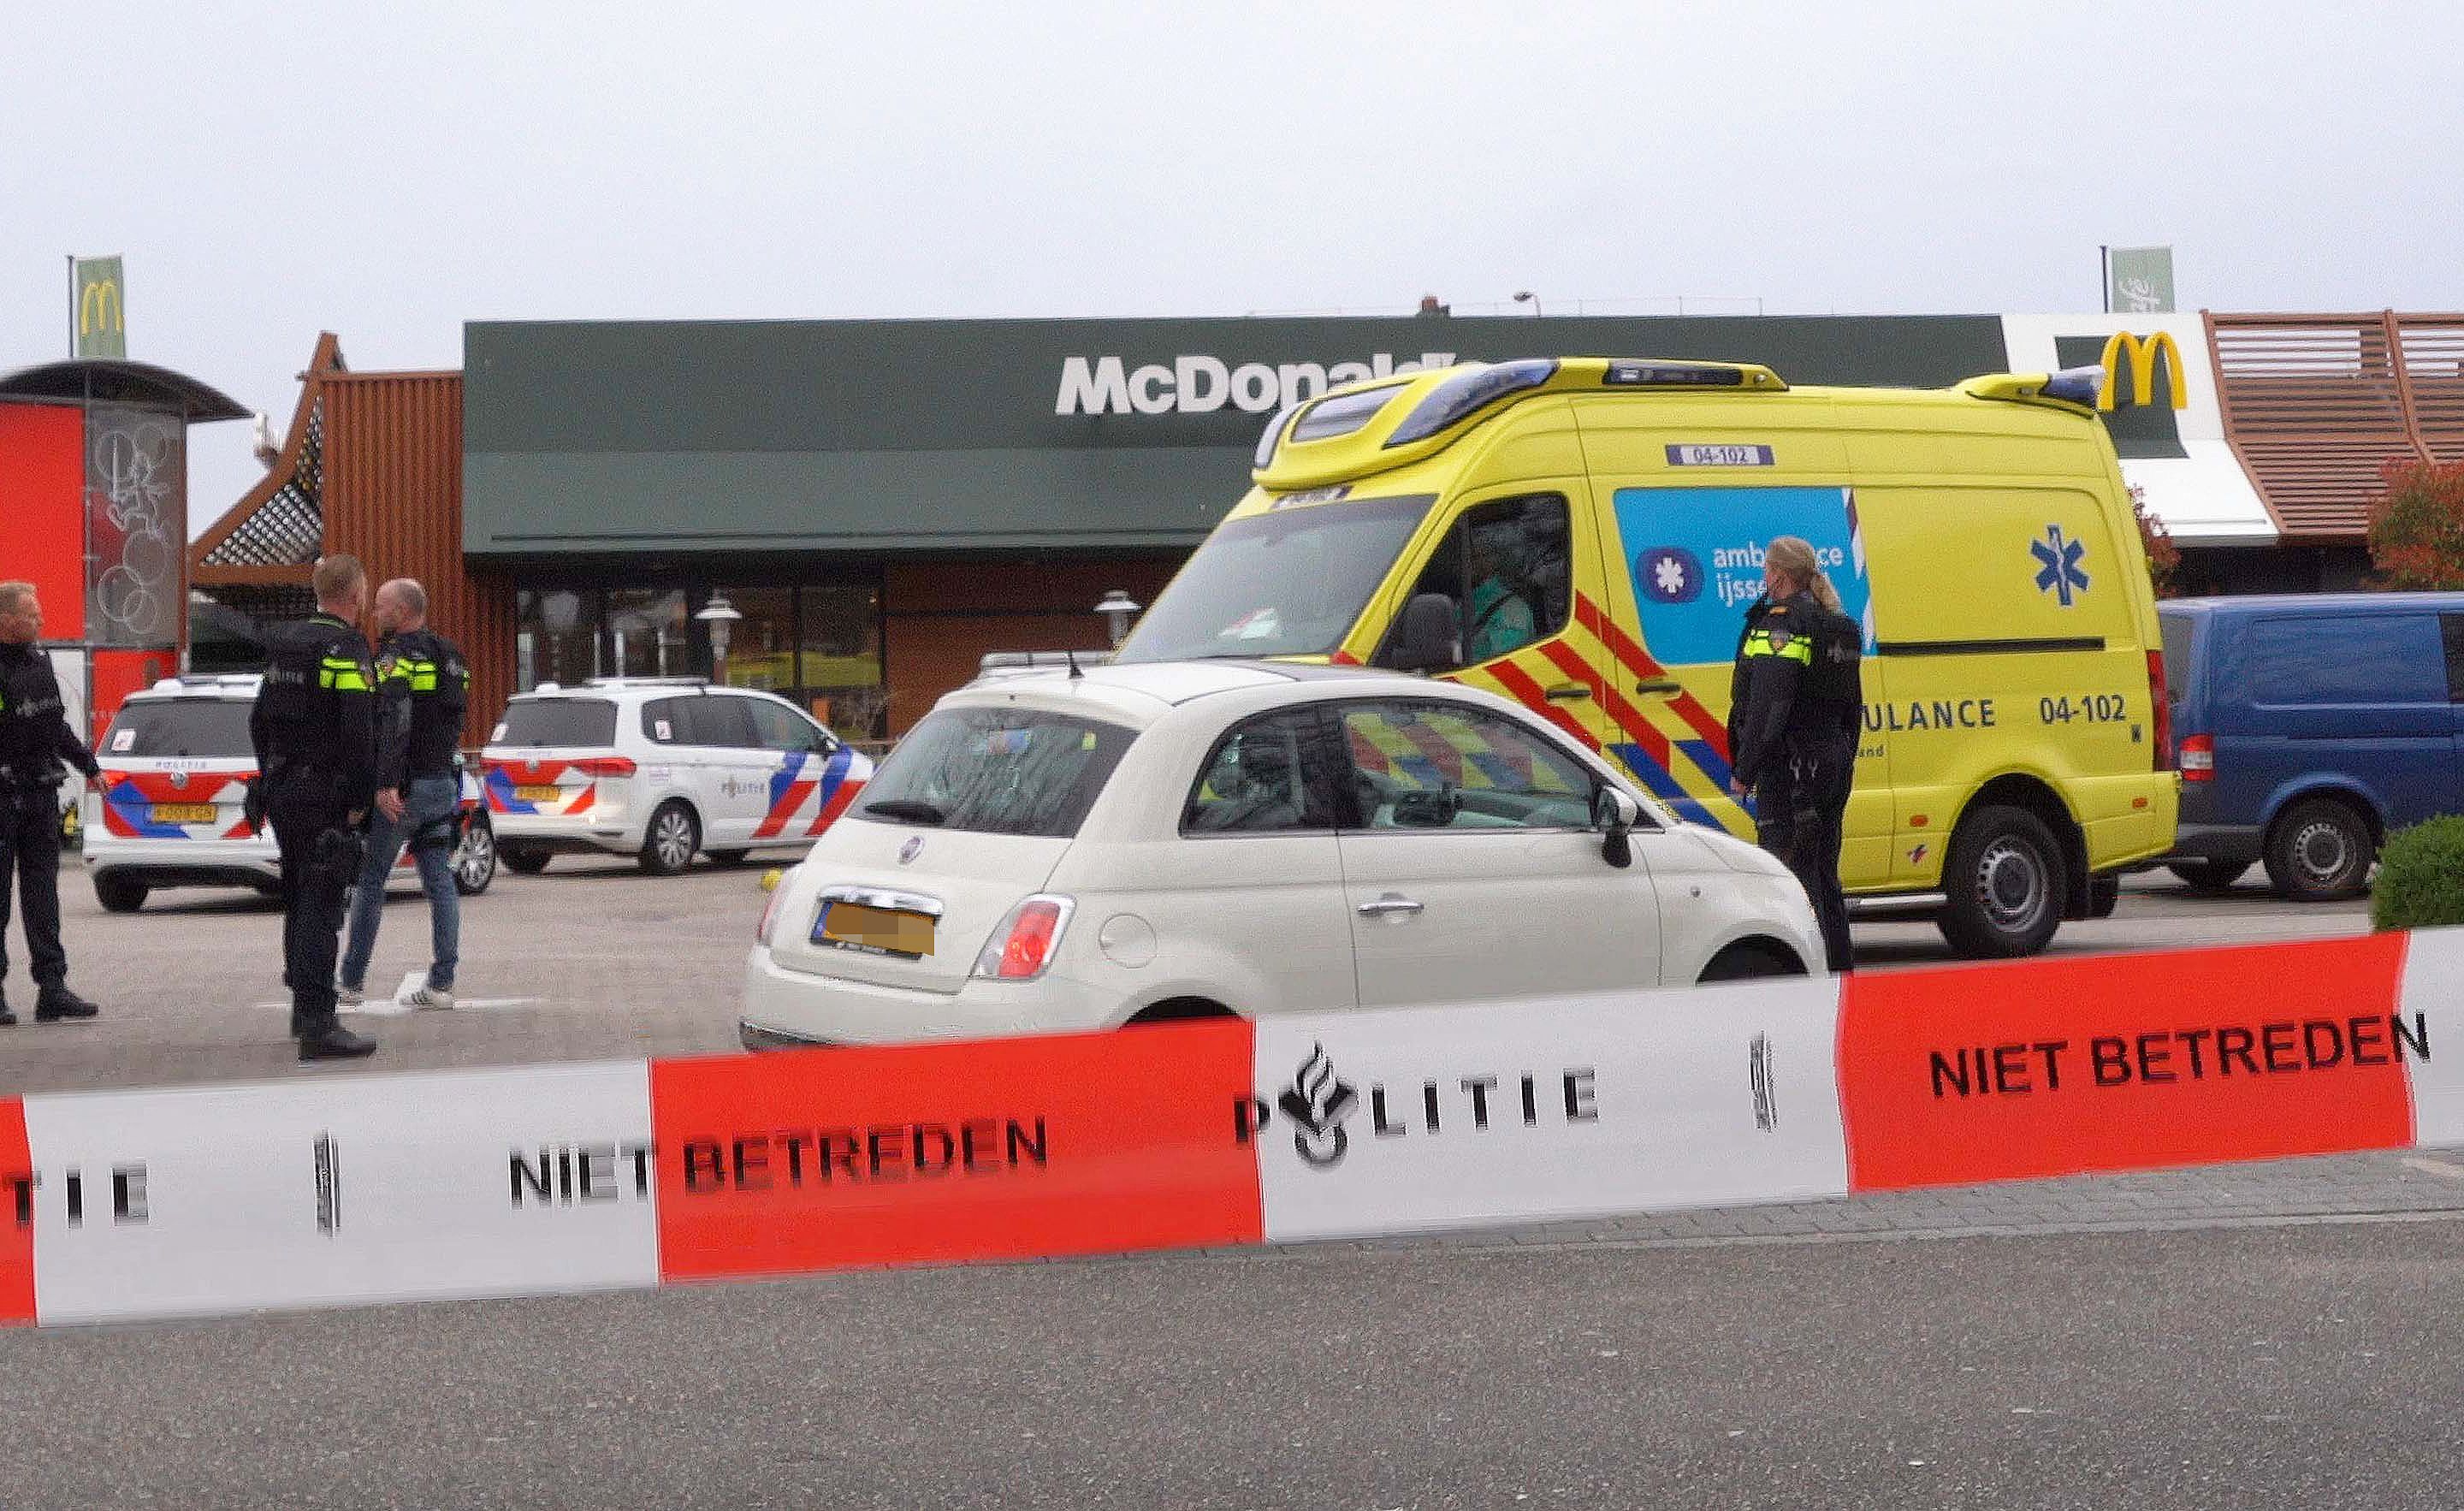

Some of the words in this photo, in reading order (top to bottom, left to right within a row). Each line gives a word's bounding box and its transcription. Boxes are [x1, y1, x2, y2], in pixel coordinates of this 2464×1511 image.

[1055, 353, 1456, 415] McDon
[2096, 330, 2189, 412] M
[1693, 447, 1746, 463] 04-102
[1713, 541, 1844, 568] ambce
[1858, 698, 1996, 732] ULANCE
[2039, 694, 2127, 726] 04-102
[1929, 1038, 2069, 1099] NIET
[2090, 1010, 2431, 1087] BETREDEN
[509, 1141, 655, 1209] NIET
[684, 1114, 1047, 1193] BETREDEN
